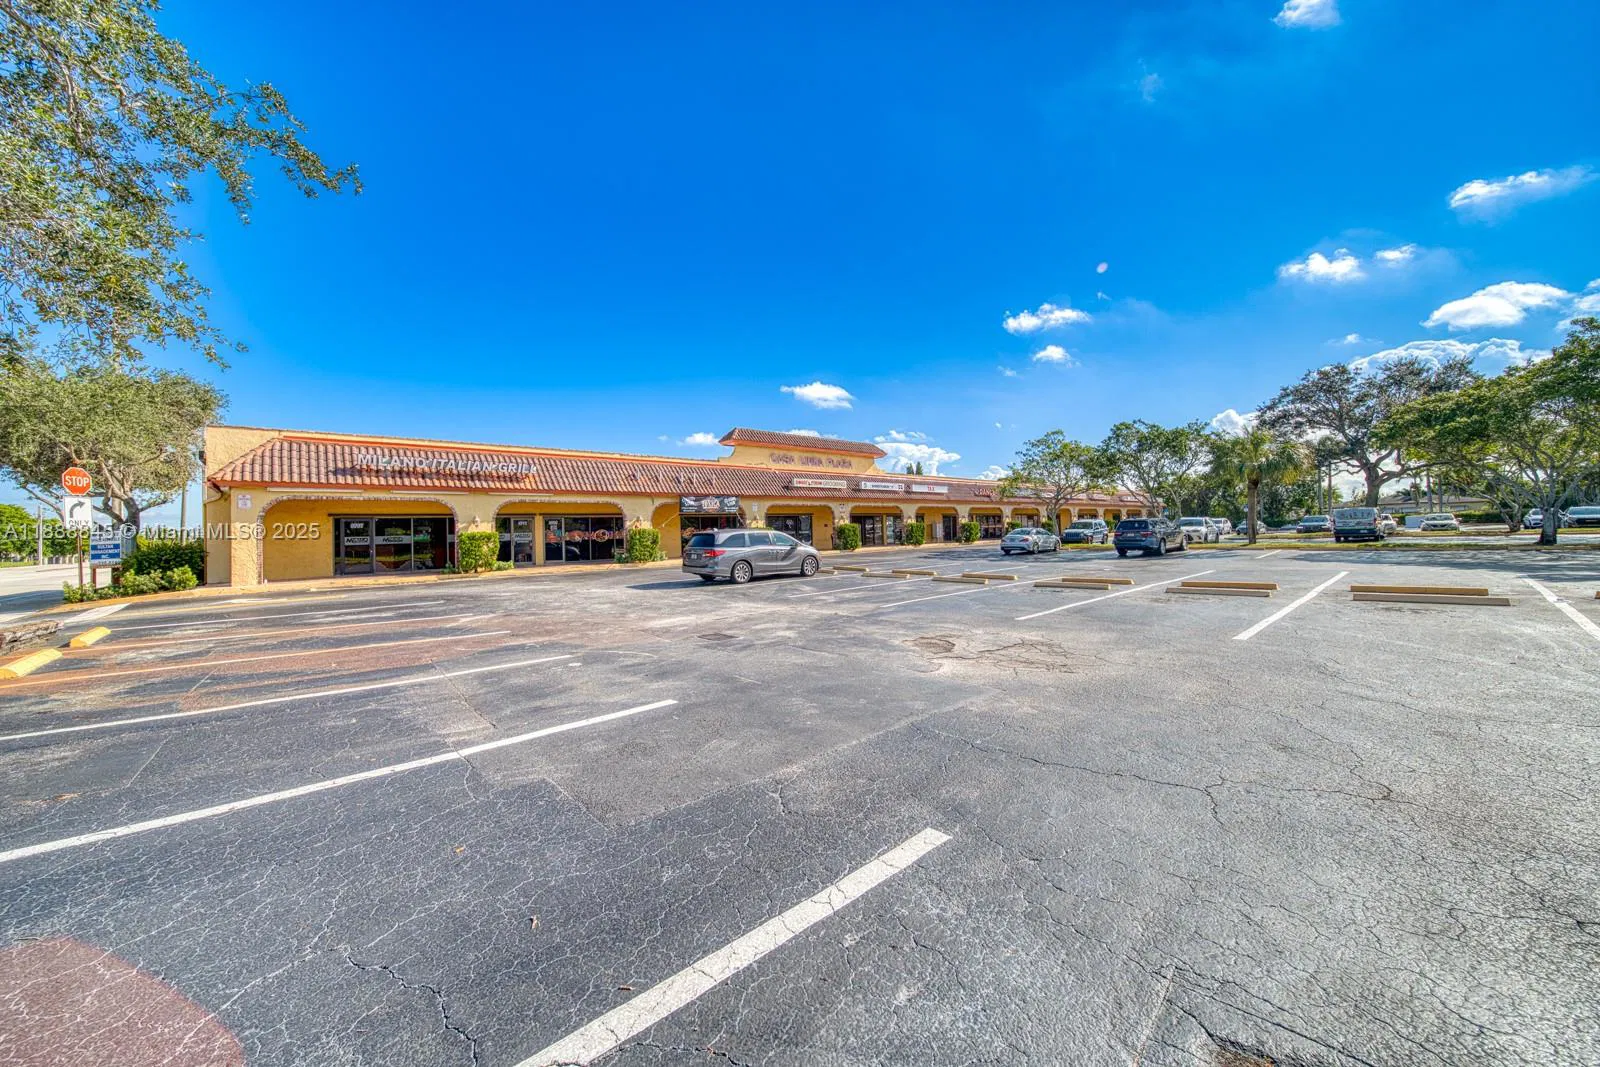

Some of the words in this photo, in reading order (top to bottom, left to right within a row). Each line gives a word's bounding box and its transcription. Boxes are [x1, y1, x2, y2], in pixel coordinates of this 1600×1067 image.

[357, 454, 427, 468] MILANO
[431, 458, 493, 471] ITALIAN
[498, 462, 537, 473] GRILL
[65, 475, 90, 487] STOP
[69, 520, 89, 528] ONLY
